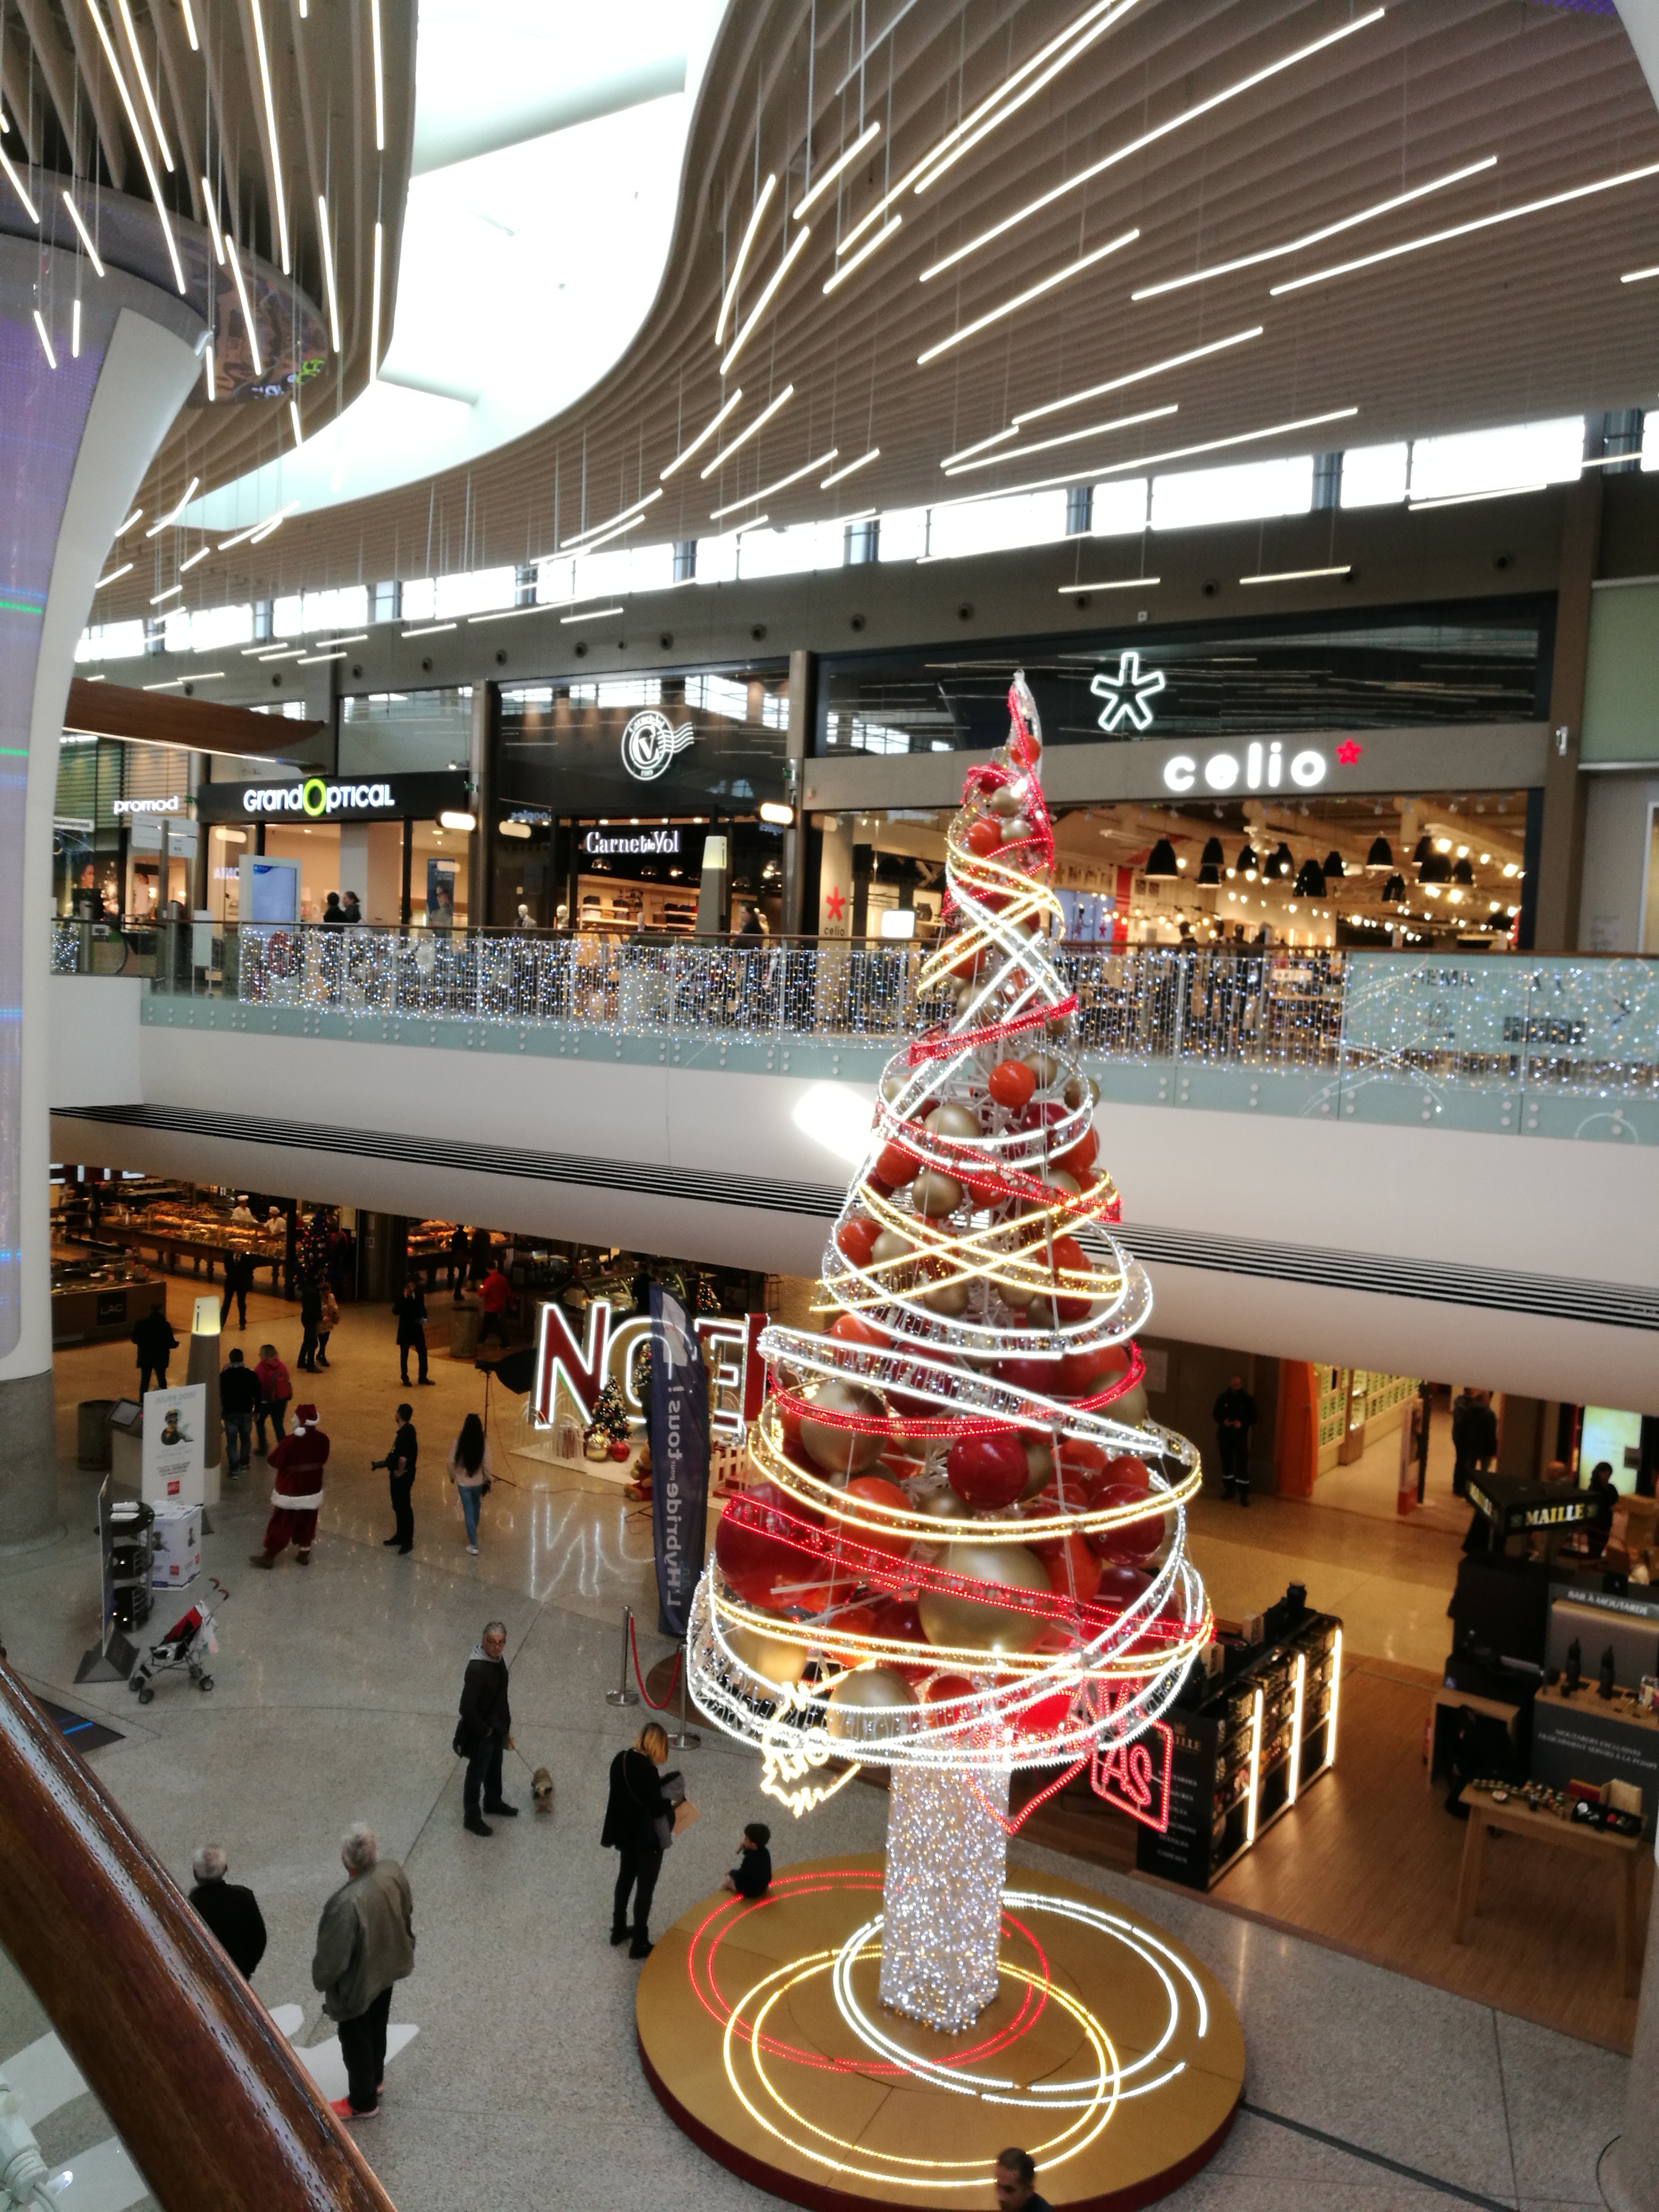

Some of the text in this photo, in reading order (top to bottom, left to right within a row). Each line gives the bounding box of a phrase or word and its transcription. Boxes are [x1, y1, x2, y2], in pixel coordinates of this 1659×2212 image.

[1164, 742, 1326, 791] celio
[113, 795, 179, 816] promod
[824, 926, 845, 936] celio
[1525, 1503, 1584, 1526] MAILLE
